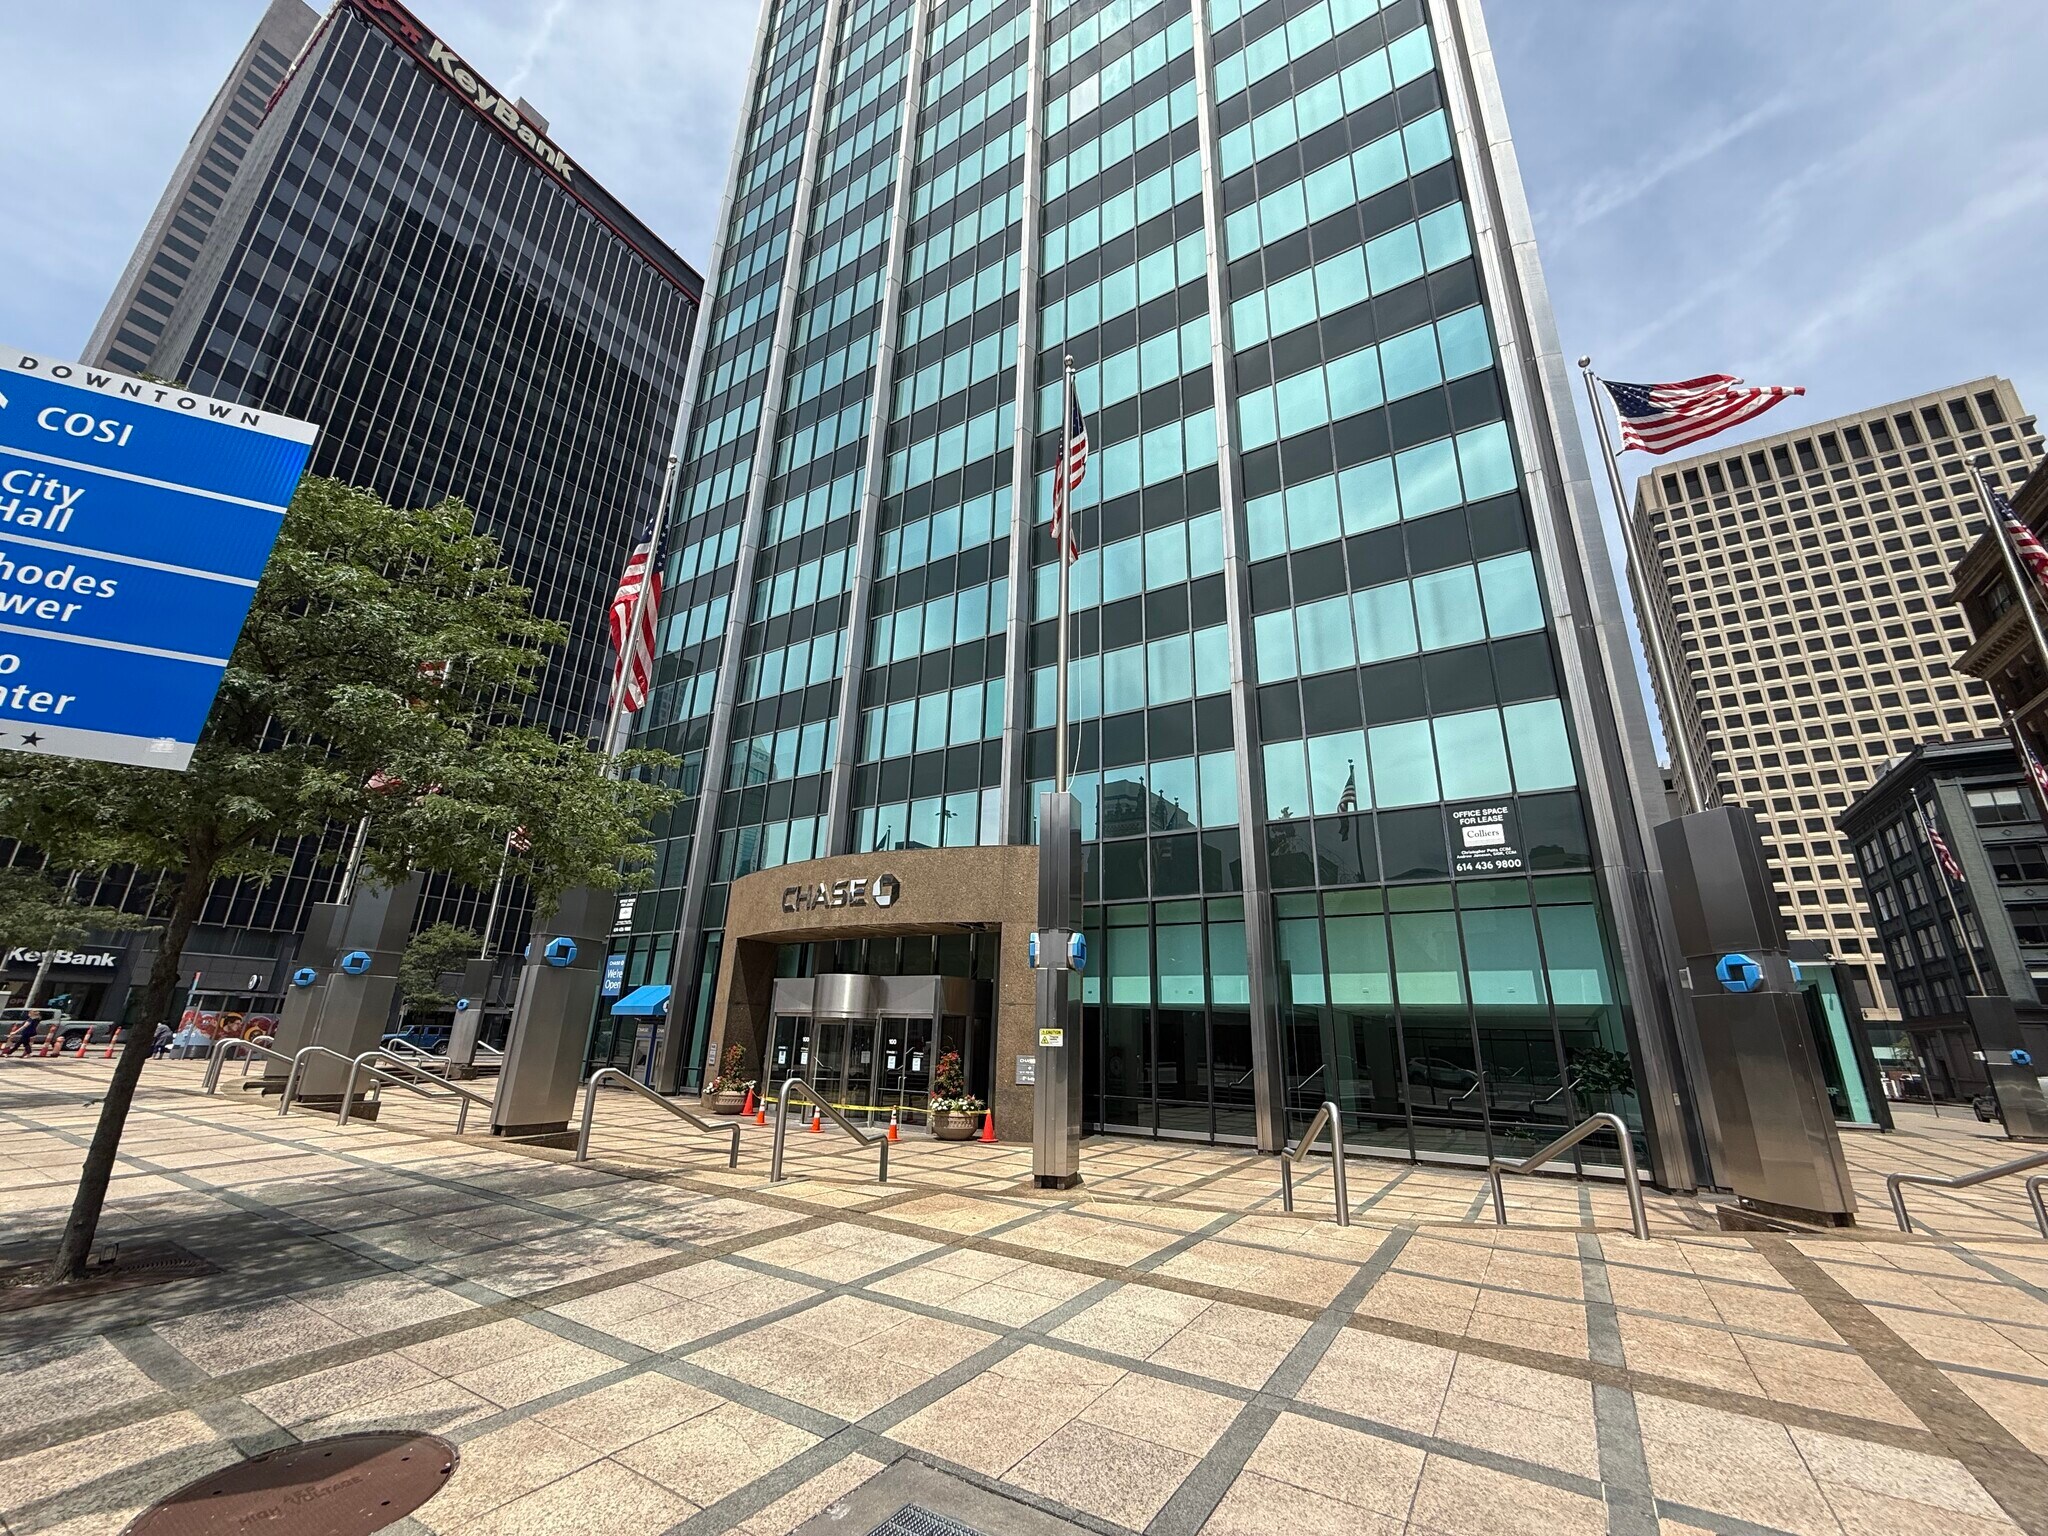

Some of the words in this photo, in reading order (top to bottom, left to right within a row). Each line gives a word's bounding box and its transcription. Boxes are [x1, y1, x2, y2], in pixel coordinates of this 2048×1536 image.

[428, 39, 574, 182] KeyBank
[18, 356, 260, 427] DOWNTOWN
[37, 407, 133, 447] COSI
[2, 469, 86, 509] City
[0, 495, 74, 532] Hall
[0, 552, 118, 598] hodes
[0, 591, 82, 622] wer
[0, 684, 76, 715] ter
[1453, 809, 1481, 819] OFFICE
[1482, 806, 1508, 816] SPACE
[1477, 814, 1504, 823] LEASE
[1467, 829, 1500, 838] Colliers
[1456, 862, 1473, 872] 614
[1475, 860, 1493, 870] 436
[1495, 859, 1522, 869] 9800
[781, 877, 868, 914] CHASE
[604, 979, 621, 991] Open
[607, 969, 623, 979] We're
